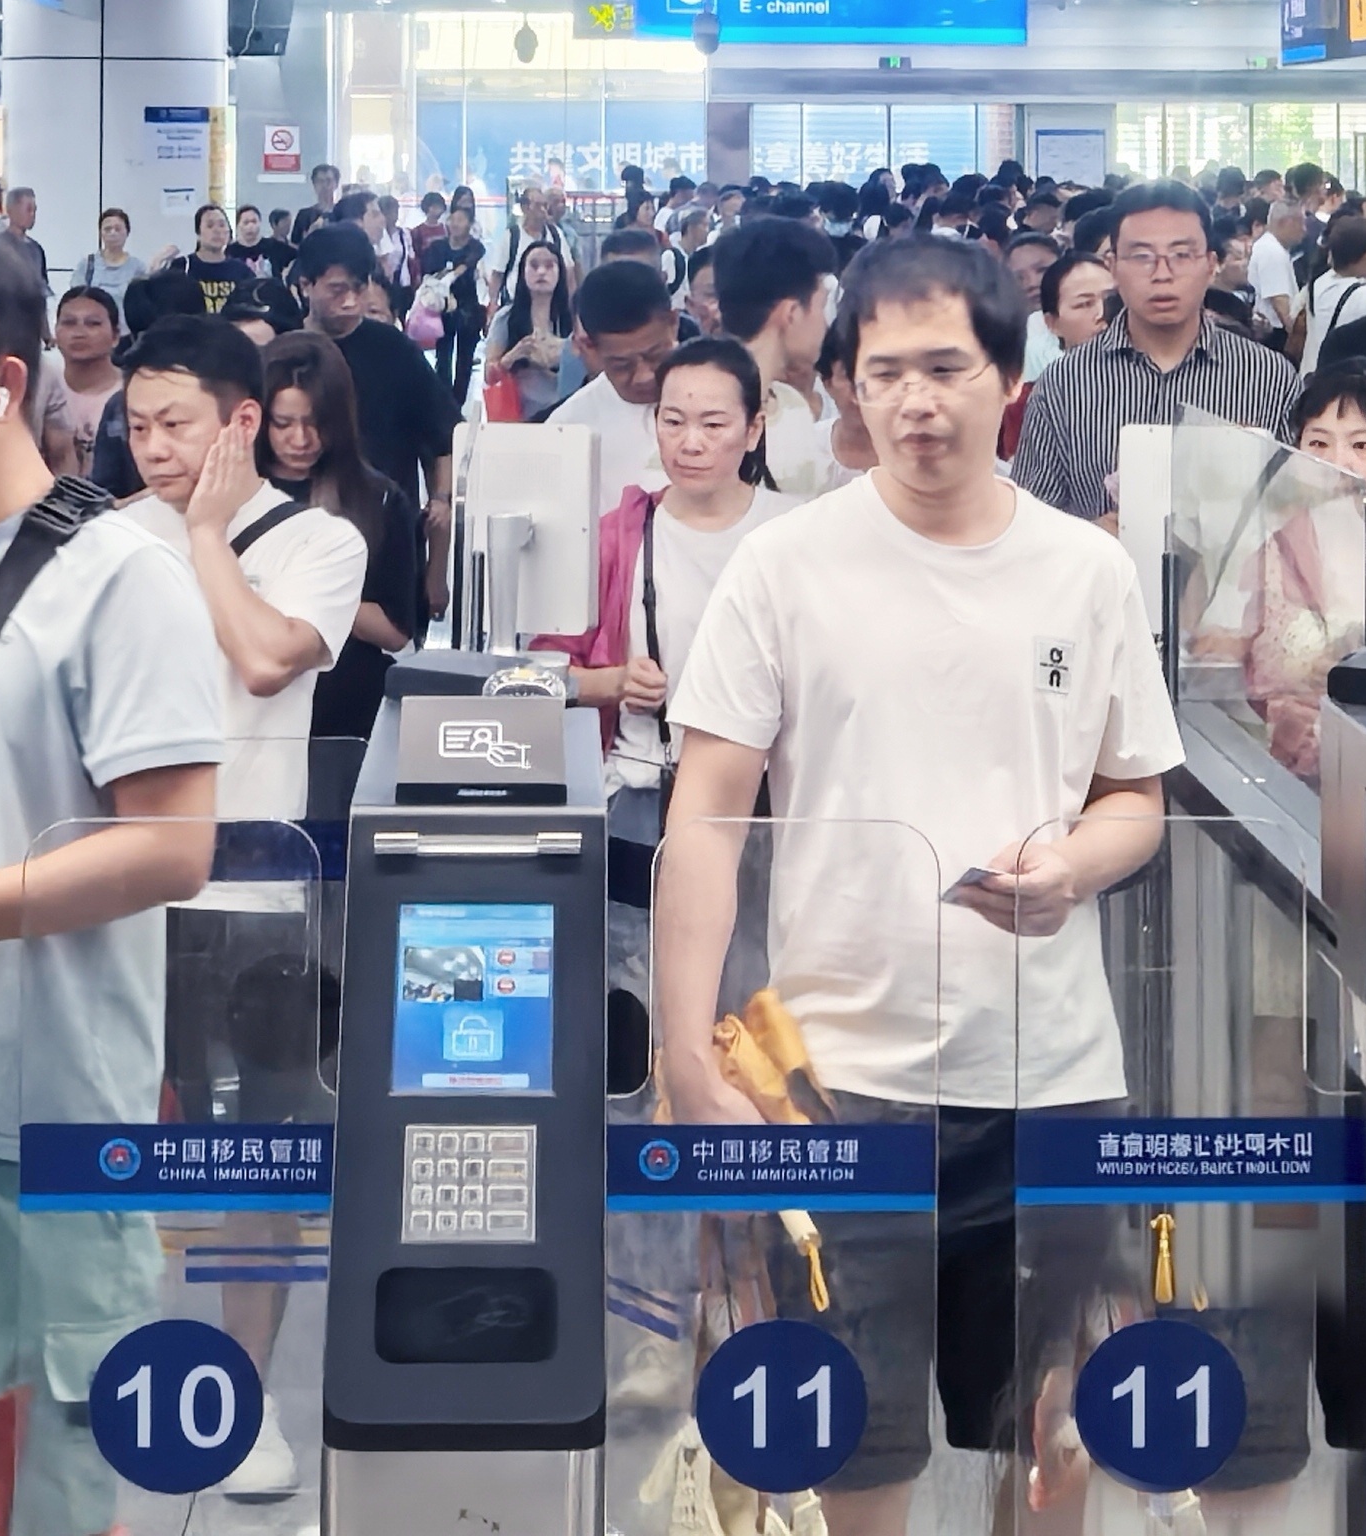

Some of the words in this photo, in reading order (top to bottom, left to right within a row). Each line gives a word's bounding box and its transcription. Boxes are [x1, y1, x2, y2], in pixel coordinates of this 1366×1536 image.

[509, 141, 707, 176] 共建文明城市
[153, 1137, 323, 1164] 中国移民管理
[692, 1138, 860, 1166] 中国移民管理
[158, 1167, 207, 1181] CHINA
[213, 1167, 317, 1181] IMMIGRATION
[697, 1168, 746, 1181] CHINA
[752, 1167, 855, 1181] IMMIGRATION
[116, 1365, 236, 1450] 10
[732, 1365, 831, 1450] 11
[1111, 1365, 1211, 1450] 11
